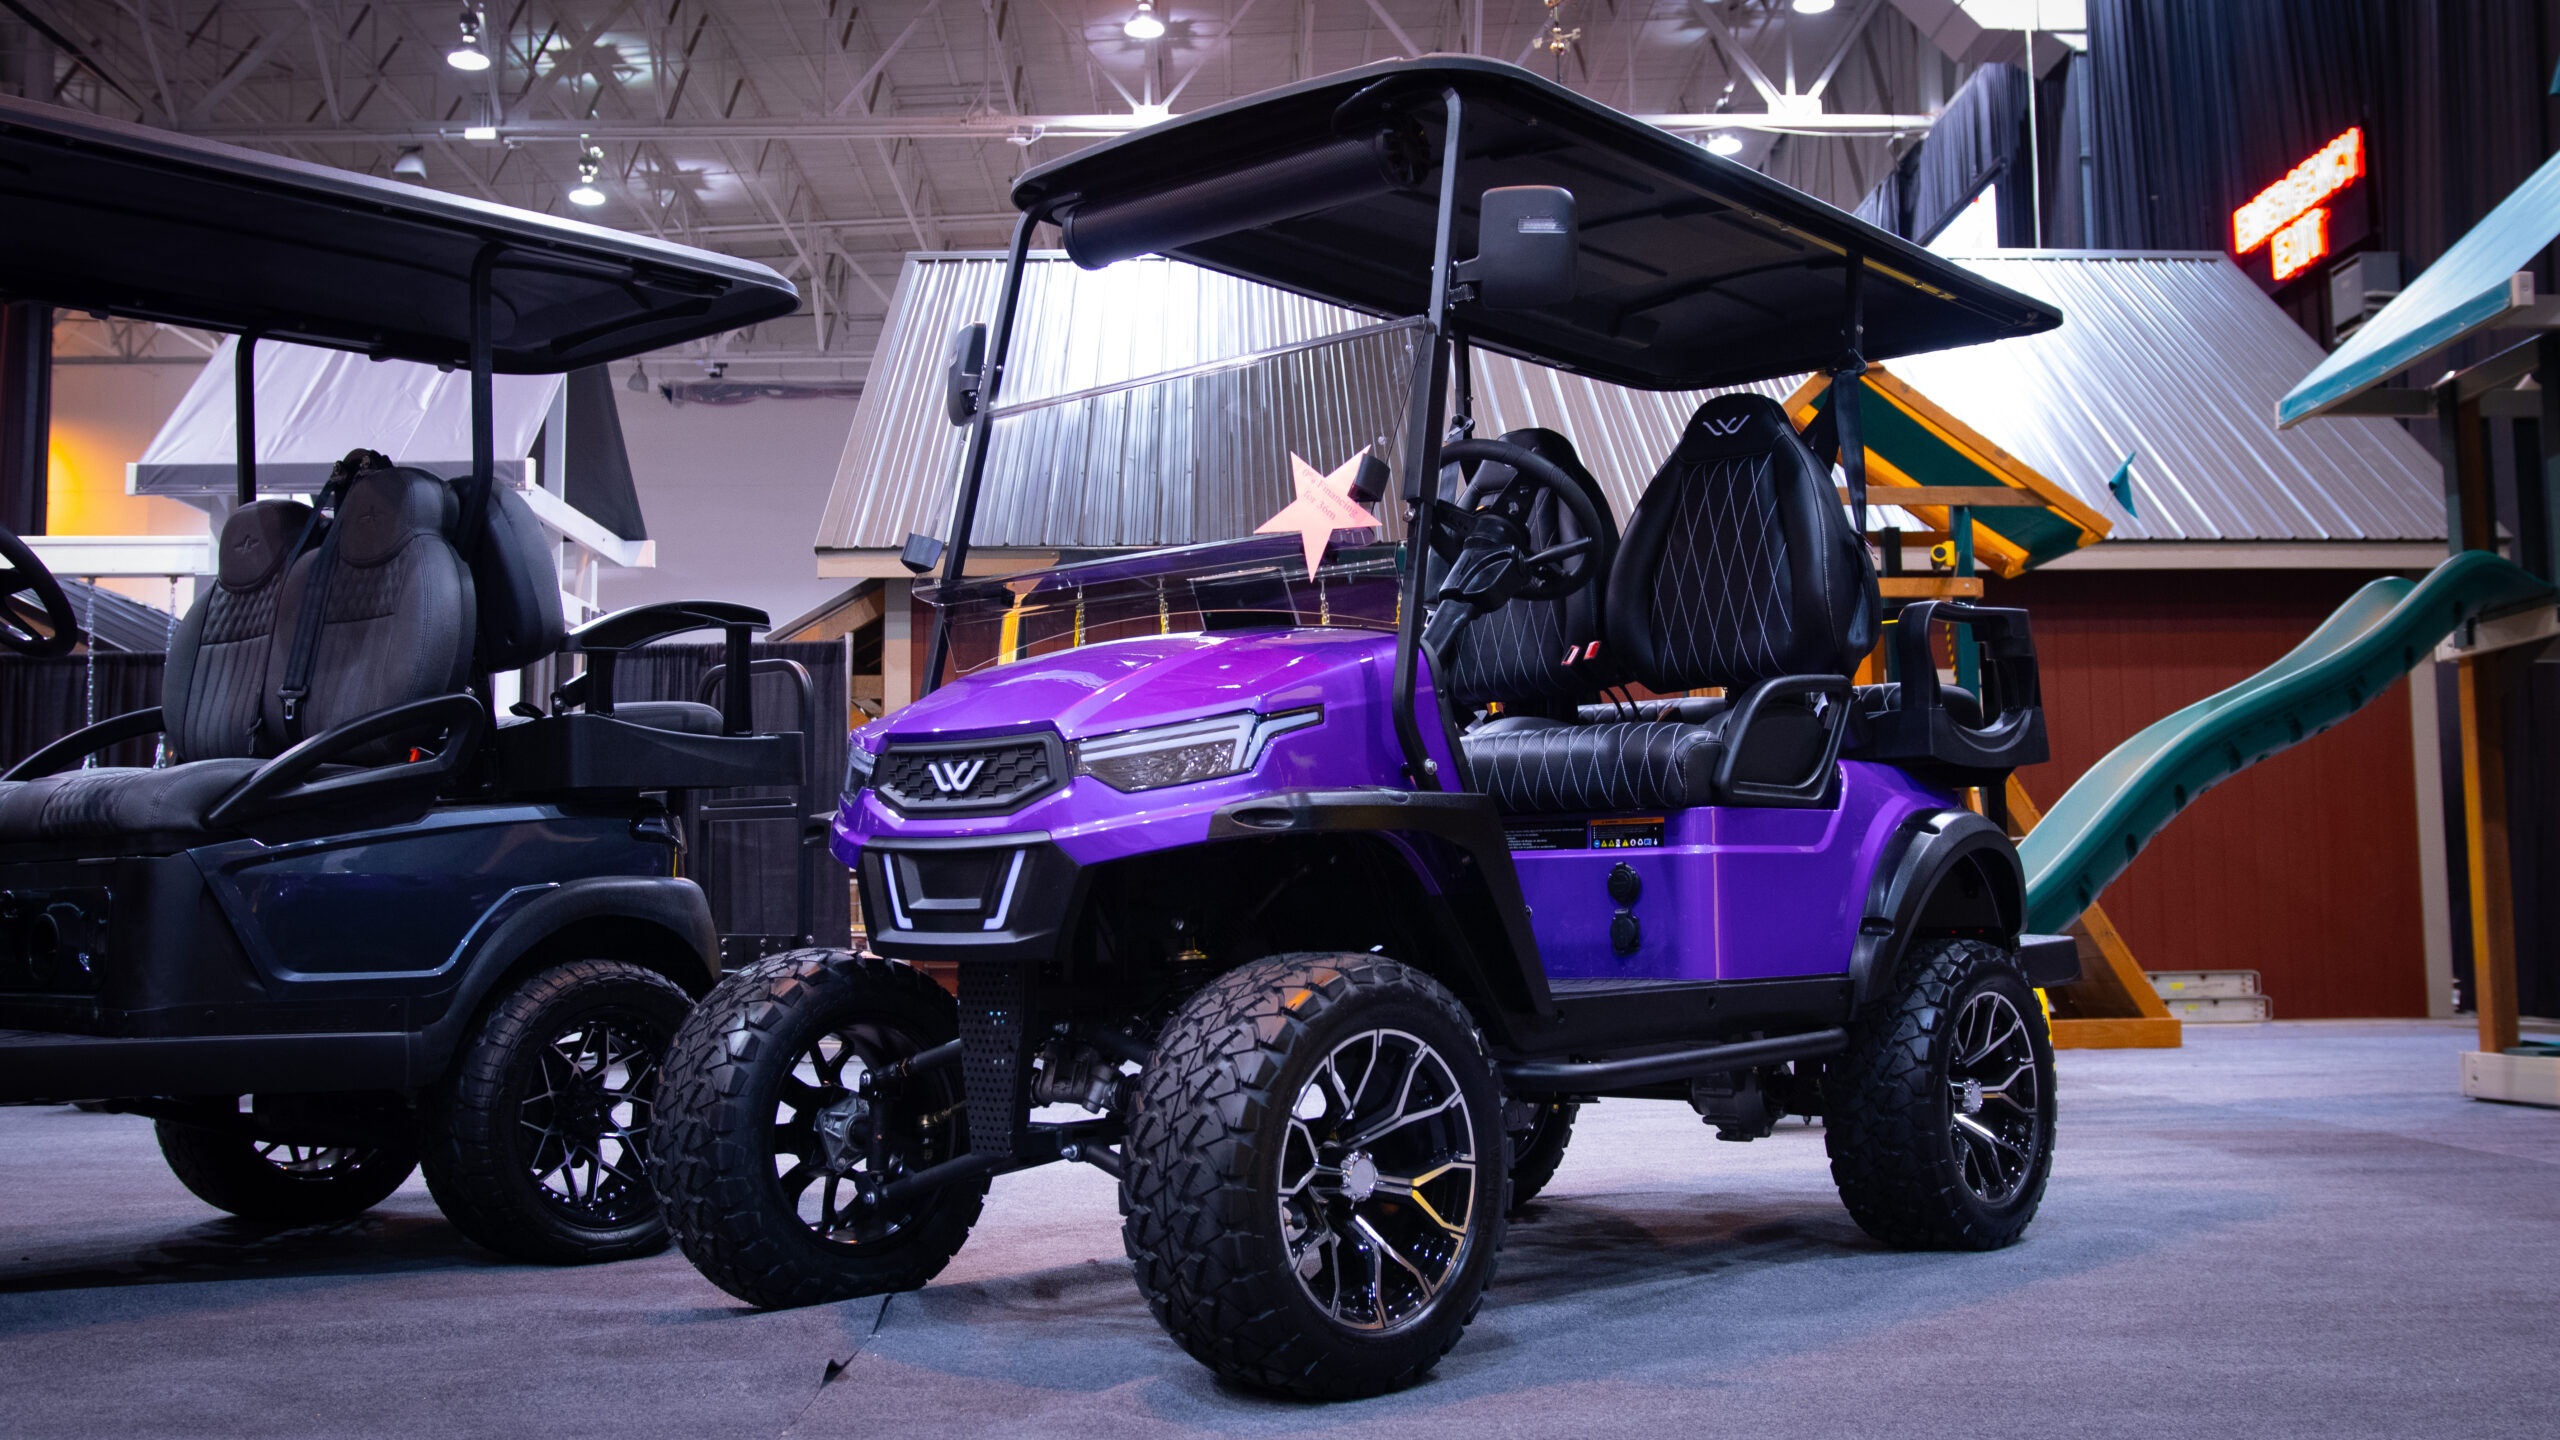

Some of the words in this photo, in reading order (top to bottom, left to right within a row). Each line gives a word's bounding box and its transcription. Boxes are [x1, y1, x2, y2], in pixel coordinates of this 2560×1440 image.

[2270, 207, 2330, 281] EXIT
[1303, 490, 1317, 503] for
[1317, 500, 1337, 521] 36m
[1317, 479, 1358, 519] Financing
